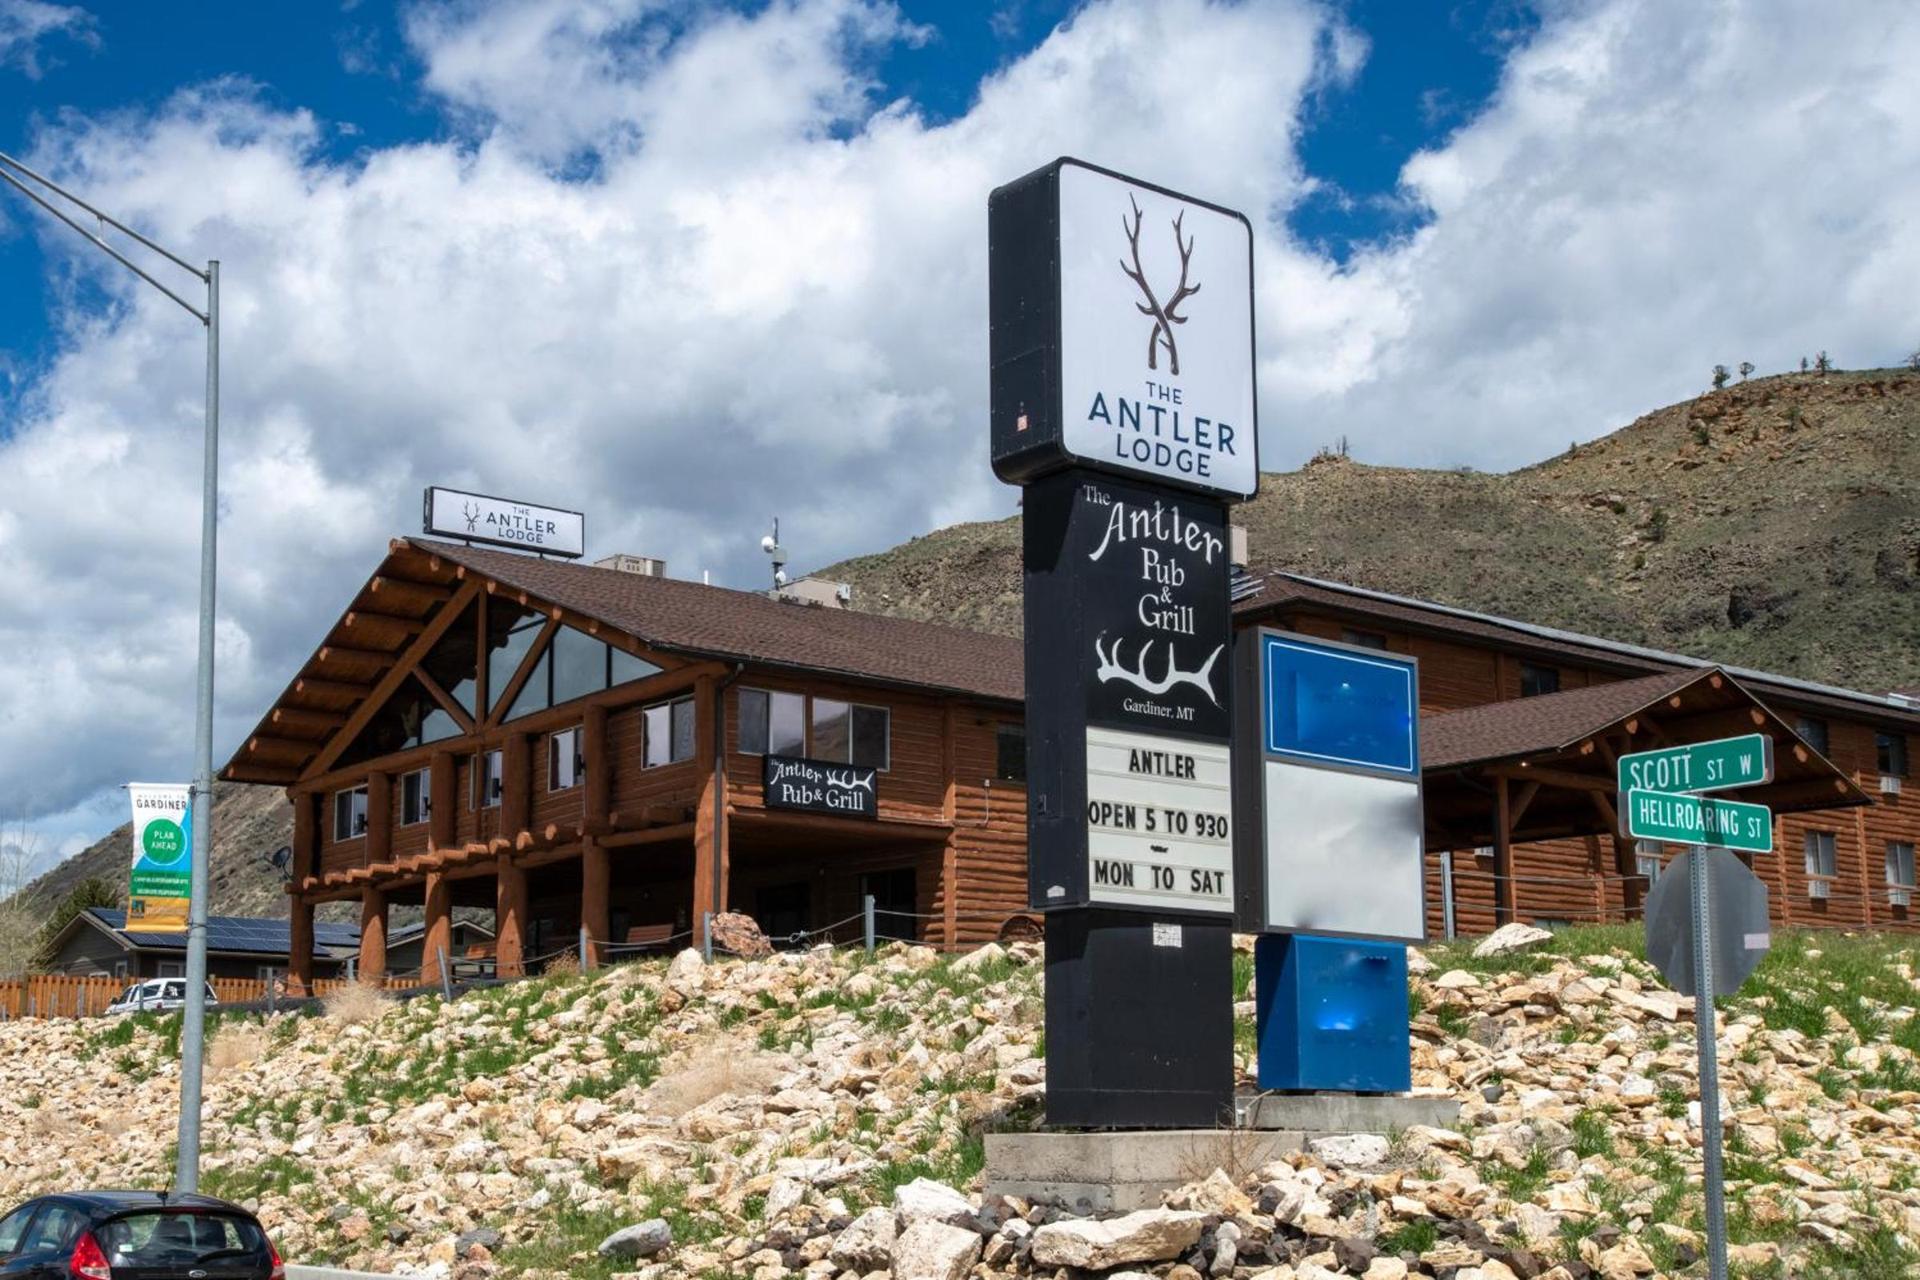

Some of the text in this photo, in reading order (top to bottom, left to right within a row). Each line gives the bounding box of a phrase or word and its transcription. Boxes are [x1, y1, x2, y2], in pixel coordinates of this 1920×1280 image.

[1146, 381, 1182, 404] THE
[1088, 392, 1236, 455] ANTLER
[1116, 433, 1210, 477] LODGE
[1083, 484, 1111, 505] The
[486, 512, 556, 535] ANTLER
[512, 506, 530, 516] THE
[498, 527, 543, 544] LODGE
[1088, 500, 1223, 565] Antler
[1141, 547, 1185, 586] Pub
[1161, 586, 1172, 604] &
[1139, 594, 1195, 635] Grill
[1123, 698, 1195, 721] Gardiner, MT
[770, 762, 822, 785] Antler
[1128, 749, 1195, 779] ANTLER
[1630, 754, 1752, 790] SCOTT ST W
[136, 799, 187, 810] GARDINER
[782, 784, 864, 811] Pub & Grill
[1088, 801, 1228, 839] OPEN 5 TO 930
[1640, 798, 1761, 838] HELLROARING ST
[151, 841, 177, 851] AHEAD
[154, 830, 174, 839] PLAN
[1094, 859, 1224, 894] MON TO SAT
